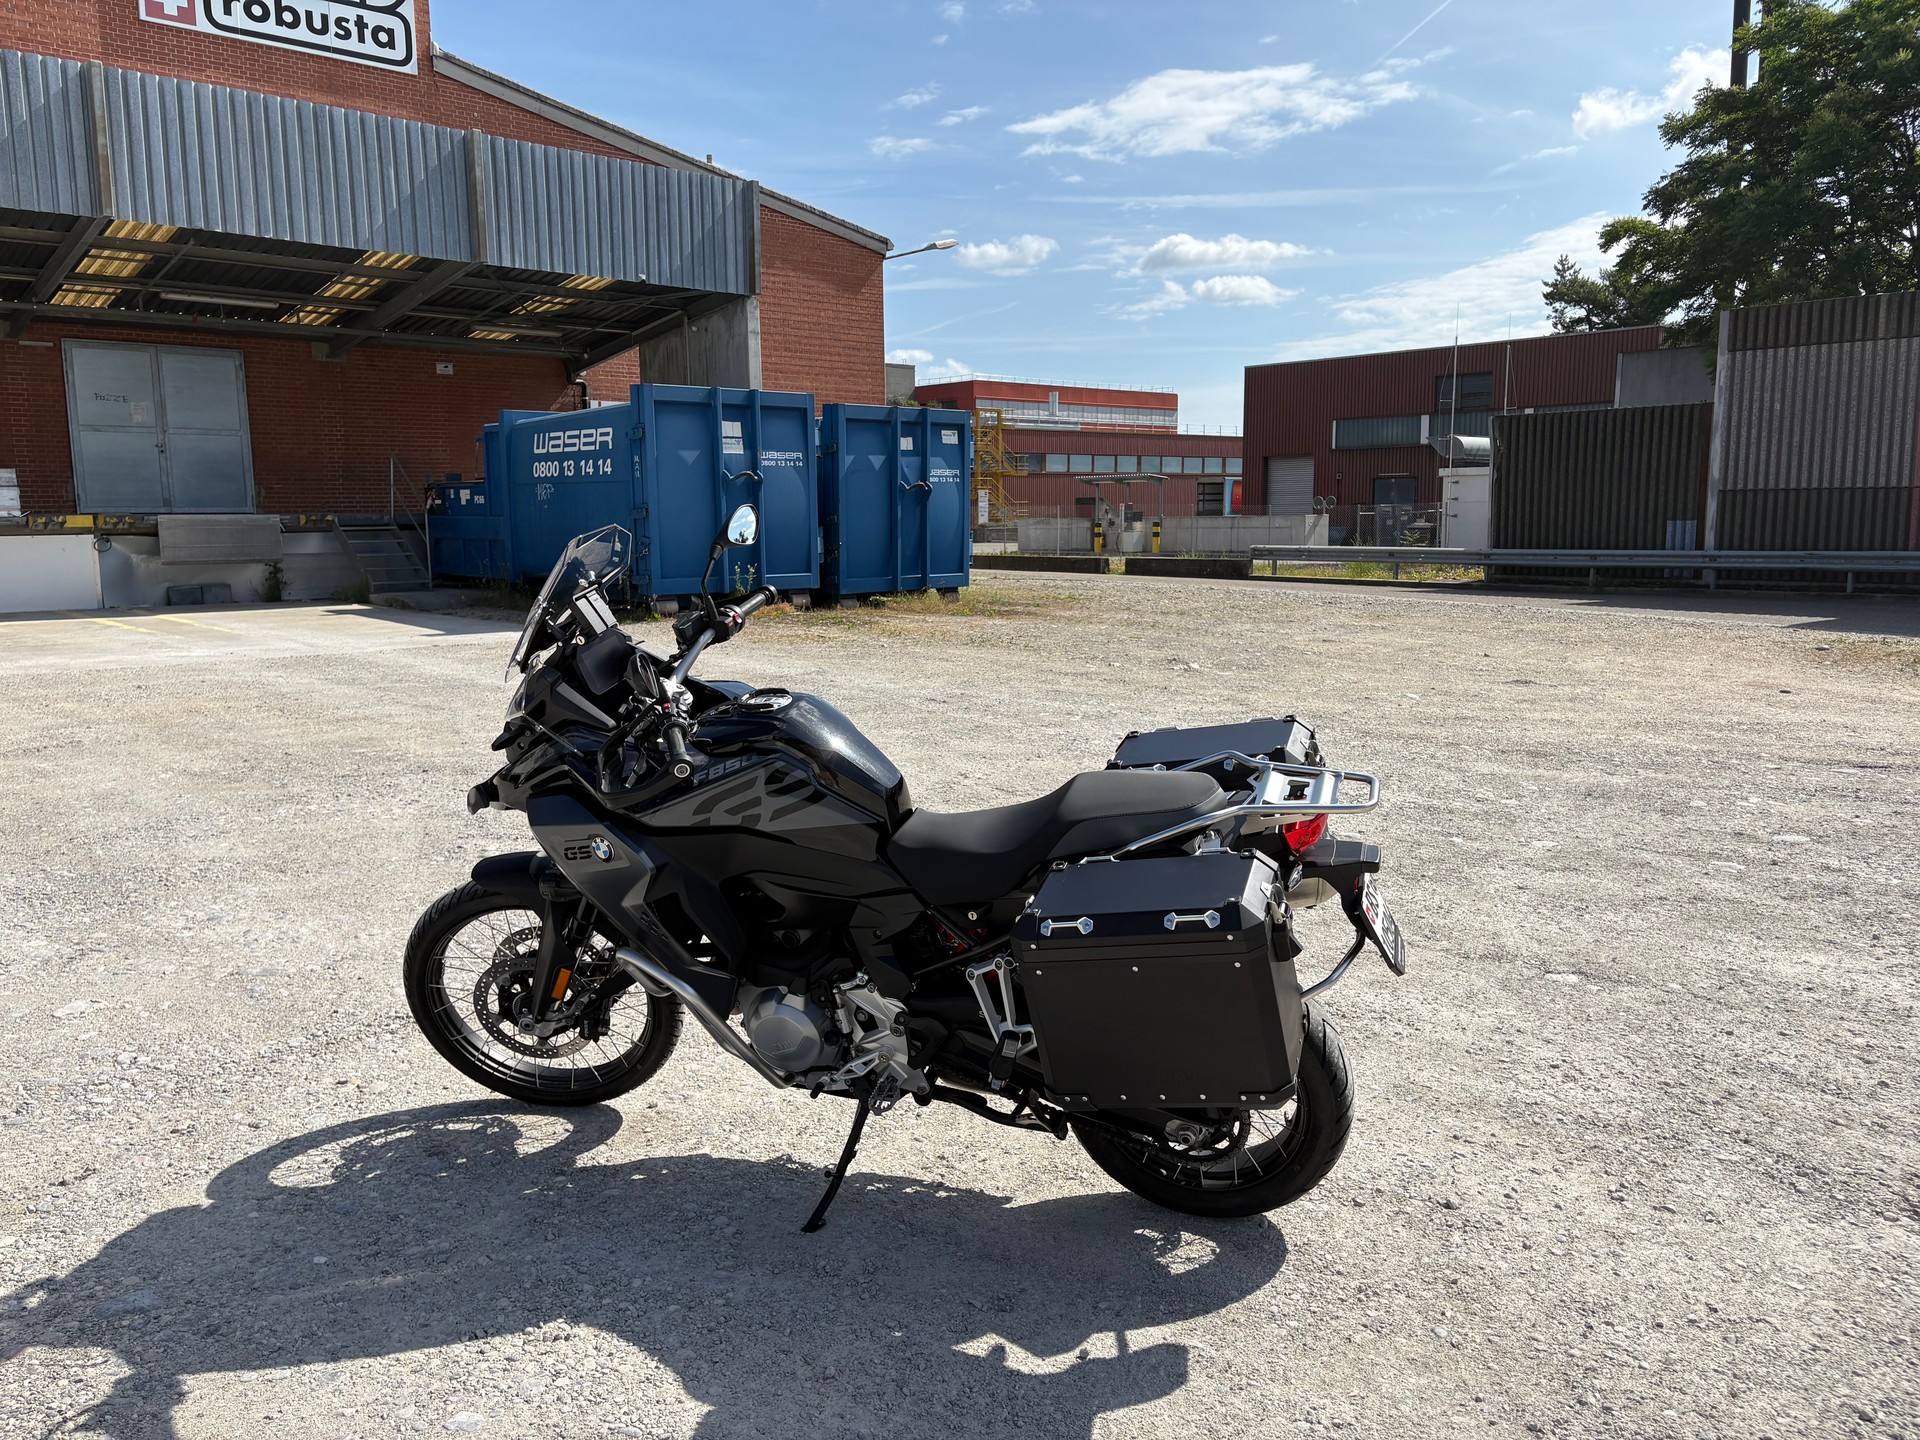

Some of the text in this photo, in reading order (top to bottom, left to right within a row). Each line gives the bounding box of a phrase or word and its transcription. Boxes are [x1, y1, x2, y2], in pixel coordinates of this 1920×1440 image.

[223, 0, 396, 50] robusta
[533, 458, 612, 478] 0800 13 14 14
[564, 845, 592, 861] GS
